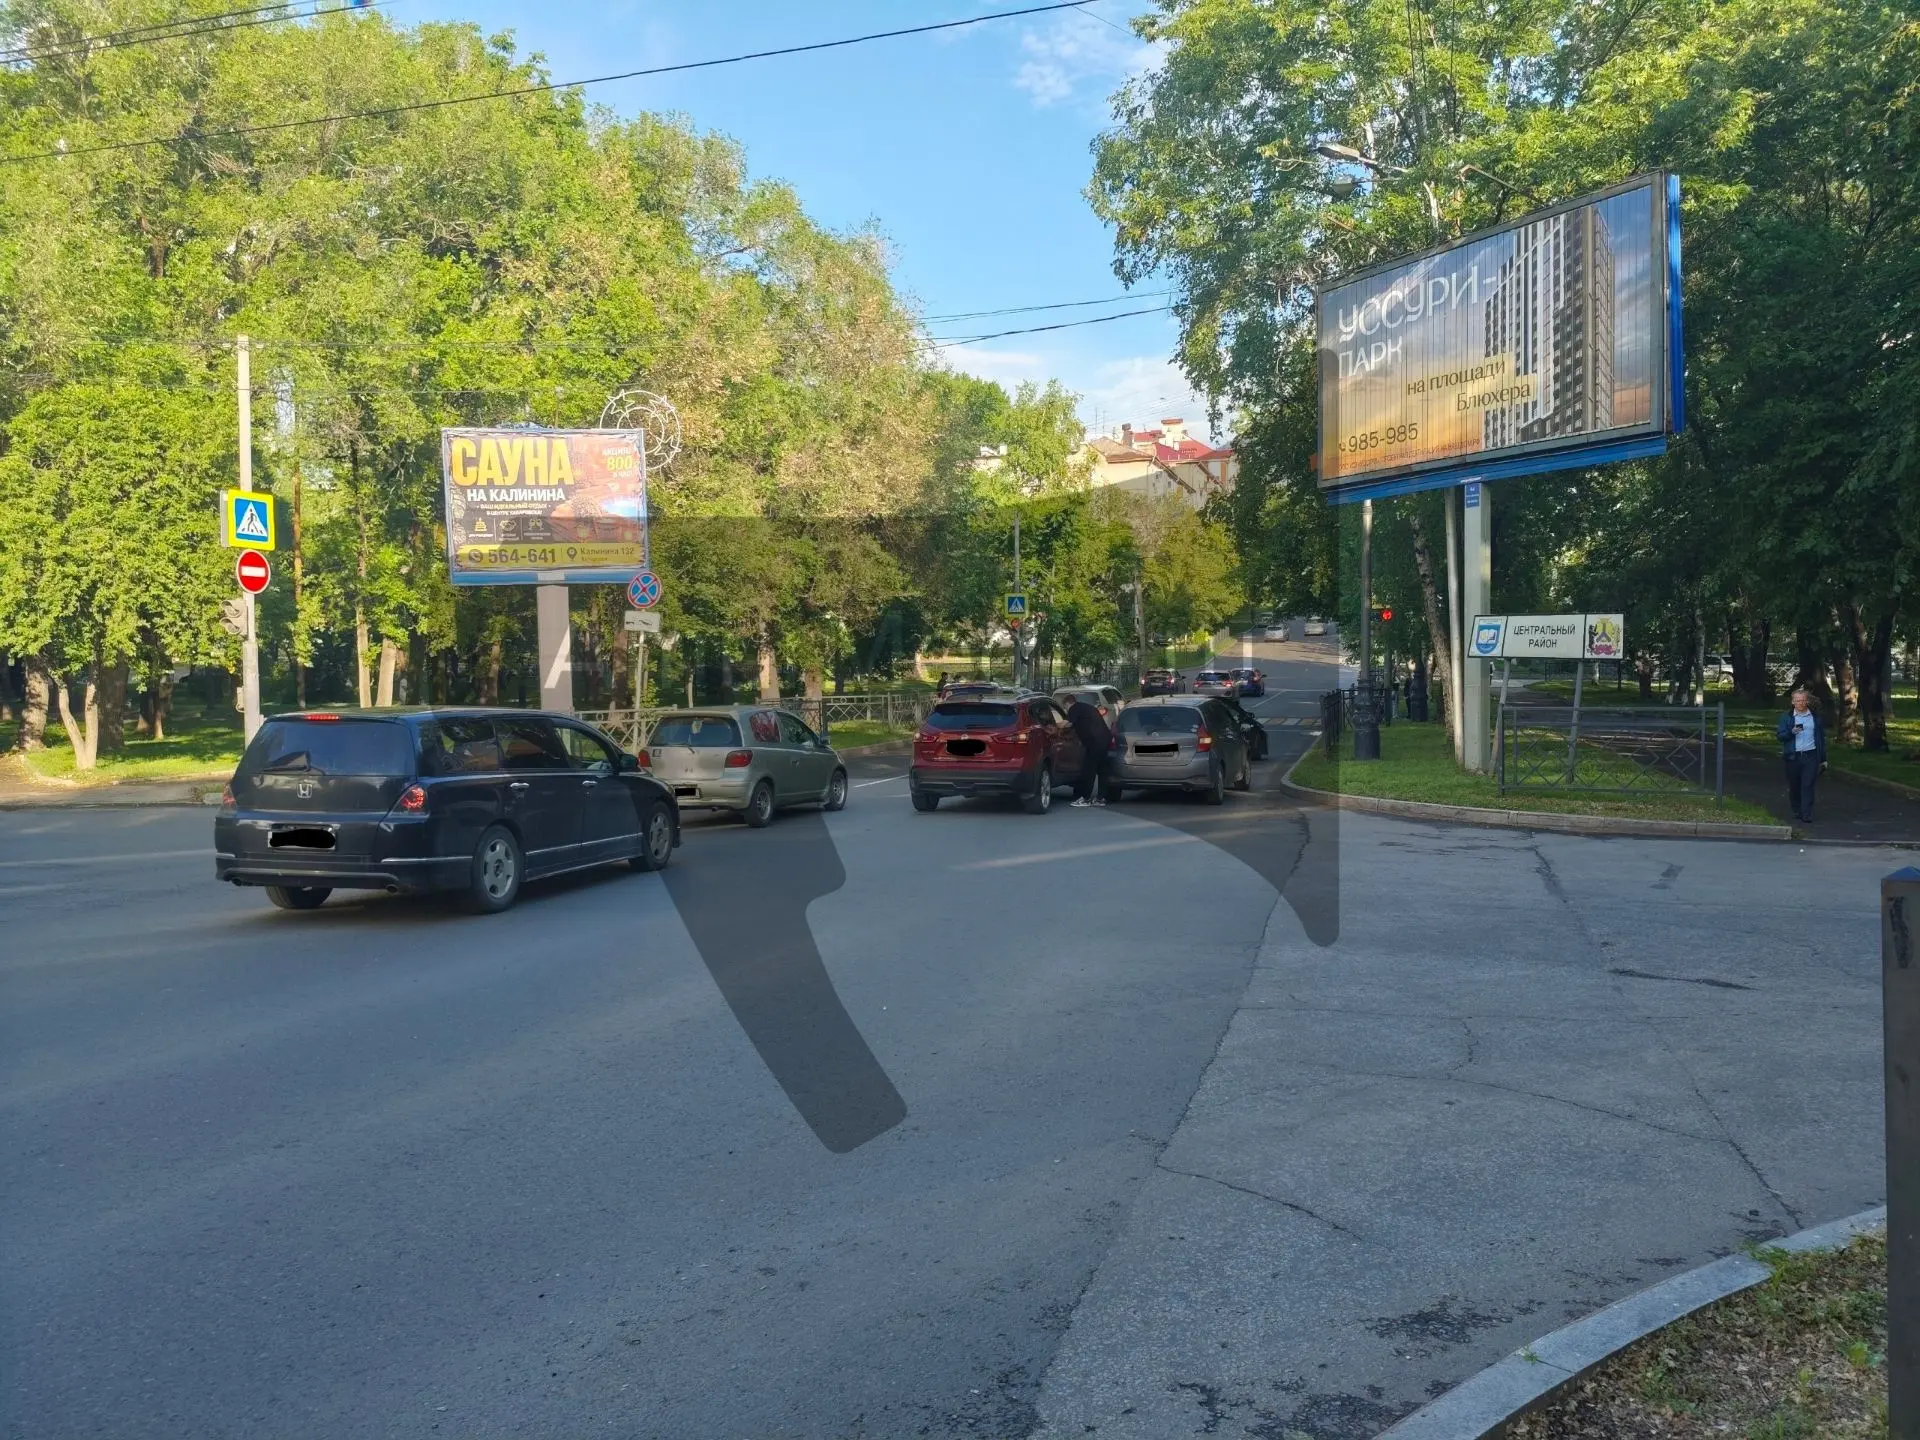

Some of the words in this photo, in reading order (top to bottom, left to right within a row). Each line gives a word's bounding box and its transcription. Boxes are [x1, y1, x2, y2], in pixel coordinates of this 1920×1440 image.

[1338, 266, 1498, 343] УССУРИ-
[1338, 336, 1403, 378] ПАРК
[1407, 380, 1425, 396] на
[1429, 359, 1506, 391] площади
[1456, 384, 1531, 413] Блюхера
[1348, 423, 1418, 454] 985-985
[451, 437, 575, 486] САУНА
[467, 488, 488, 502] НА
[490, 488, 566, 502] КАЛИНИНА
[488, 548, 557, 564] 564-641
[580, 547, 619, 555] Калинина
[1513, 624, 1576, 636] ЦЕНТРАЛЬНЫЙ
[1528, 637, 1557, 648] РАЙОН
